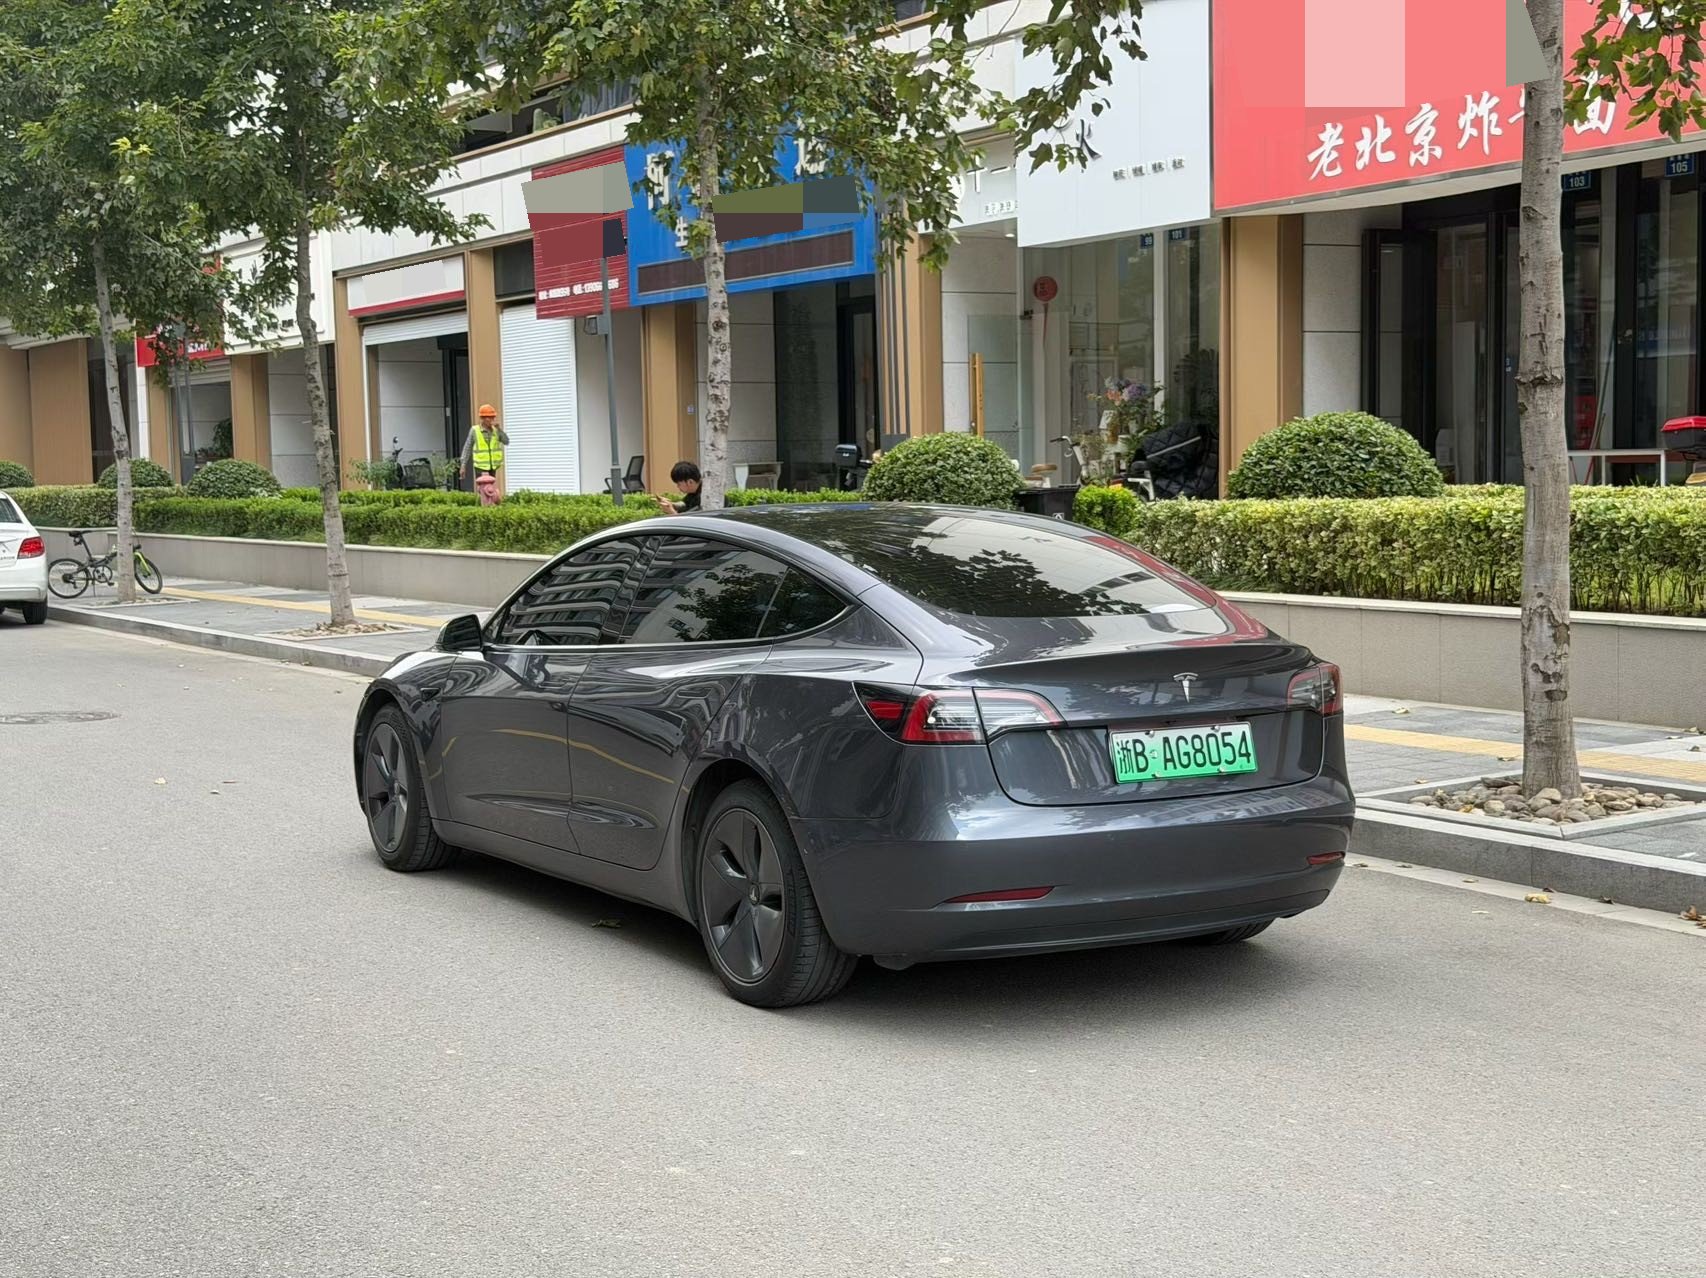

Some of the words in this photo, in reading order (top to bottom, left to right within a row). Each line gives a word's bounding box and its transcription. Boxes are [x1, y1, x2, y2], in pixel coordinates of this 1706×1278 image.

[1306, 67, 1616, 181] 老北京炸面
[1671, 161, 1688, 173] 105
[1569, 176, 1585, 188] 103
